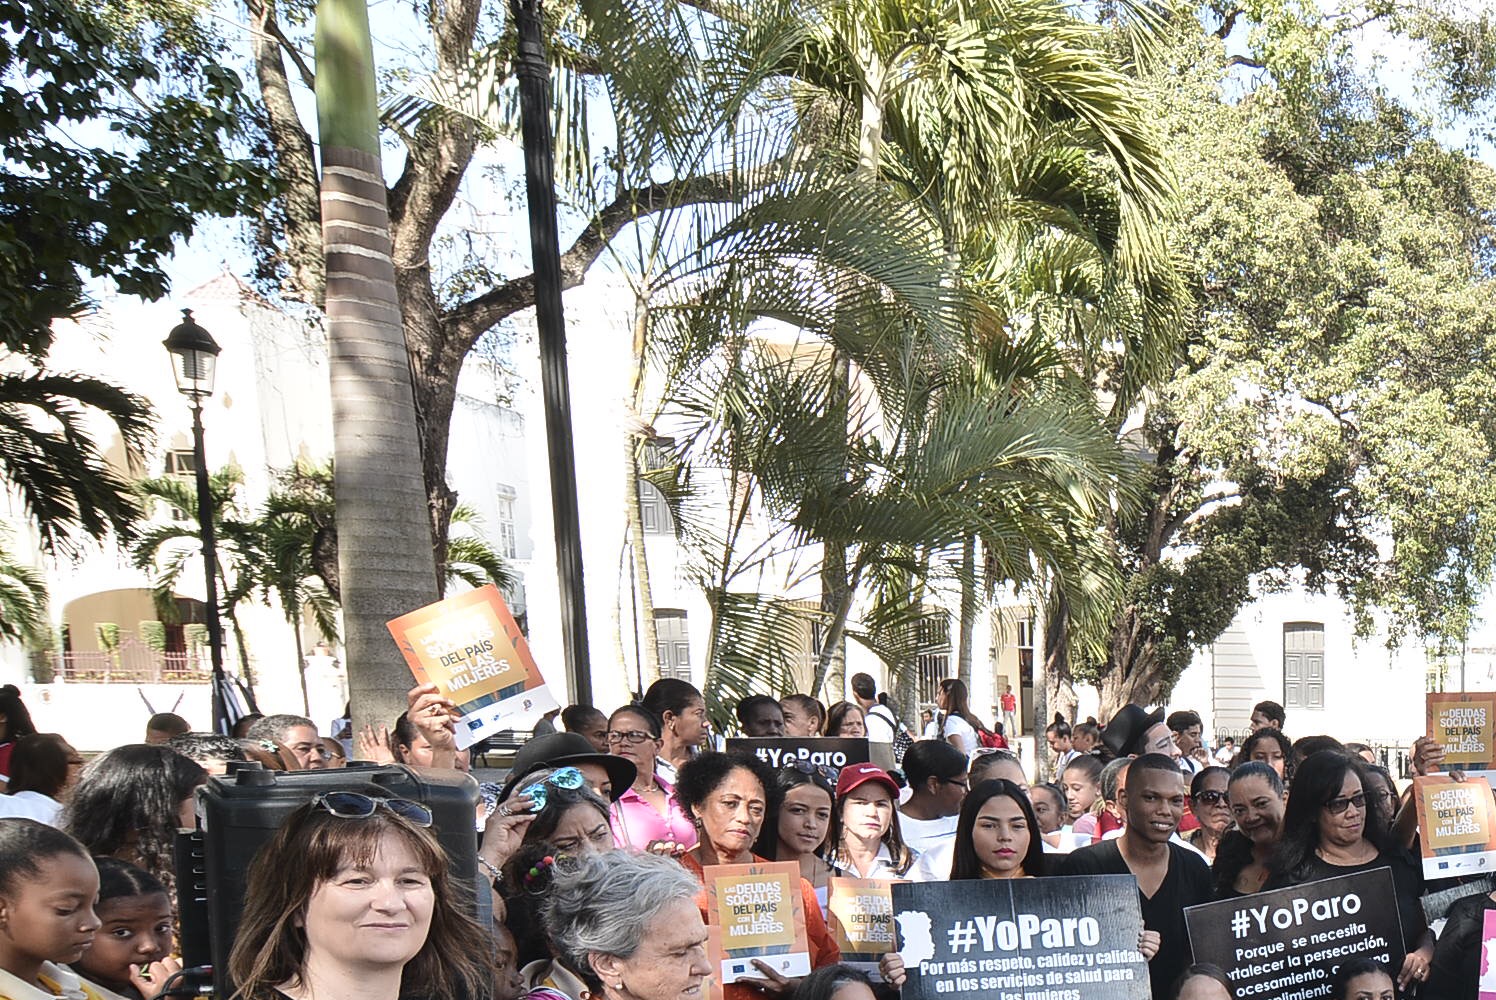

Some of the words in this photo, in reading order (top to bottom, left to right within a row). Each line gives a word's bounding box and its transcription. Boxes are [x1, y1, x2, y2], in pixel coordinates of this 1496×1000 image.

[726, 891, 782, 906] SOCIALES
[736, 881, 781, 896] DEUDAS
[733, 904, 752, 915] DEL
[754, 901, 778, 913] PAÍS
[751, 912, 774, 924] LAS
[1231, 893, 1362, 939] #YoParo
[729, 922, 784, 937] MUJERES
[947, 914, 1100, 954] #YoParo
[1235, 941, 1285, 962] Porque
[1292, 936, 1308, 949] se
[1310, 922, 1366, 946] necesita
[920, 960, 944, 976] Por
[947, 955, 977, 974] más
[979, 956, 1035, 974] respeto,
[1037, 950, 1086, 969] calidez
[1086, 953, 1094, 968] y
[1288, 954, 1301, 968] la
[1304, 937, 1388, 963] persecución,
[936, 978, 954, 993] en
[956, 974, 979, 992] los
[980, 972, 1044, 991] servicios
[1046, 970, 1064, 986] de
[1065, 968, 1101, 985] salud
[1104, 967, 1134, 983] para
